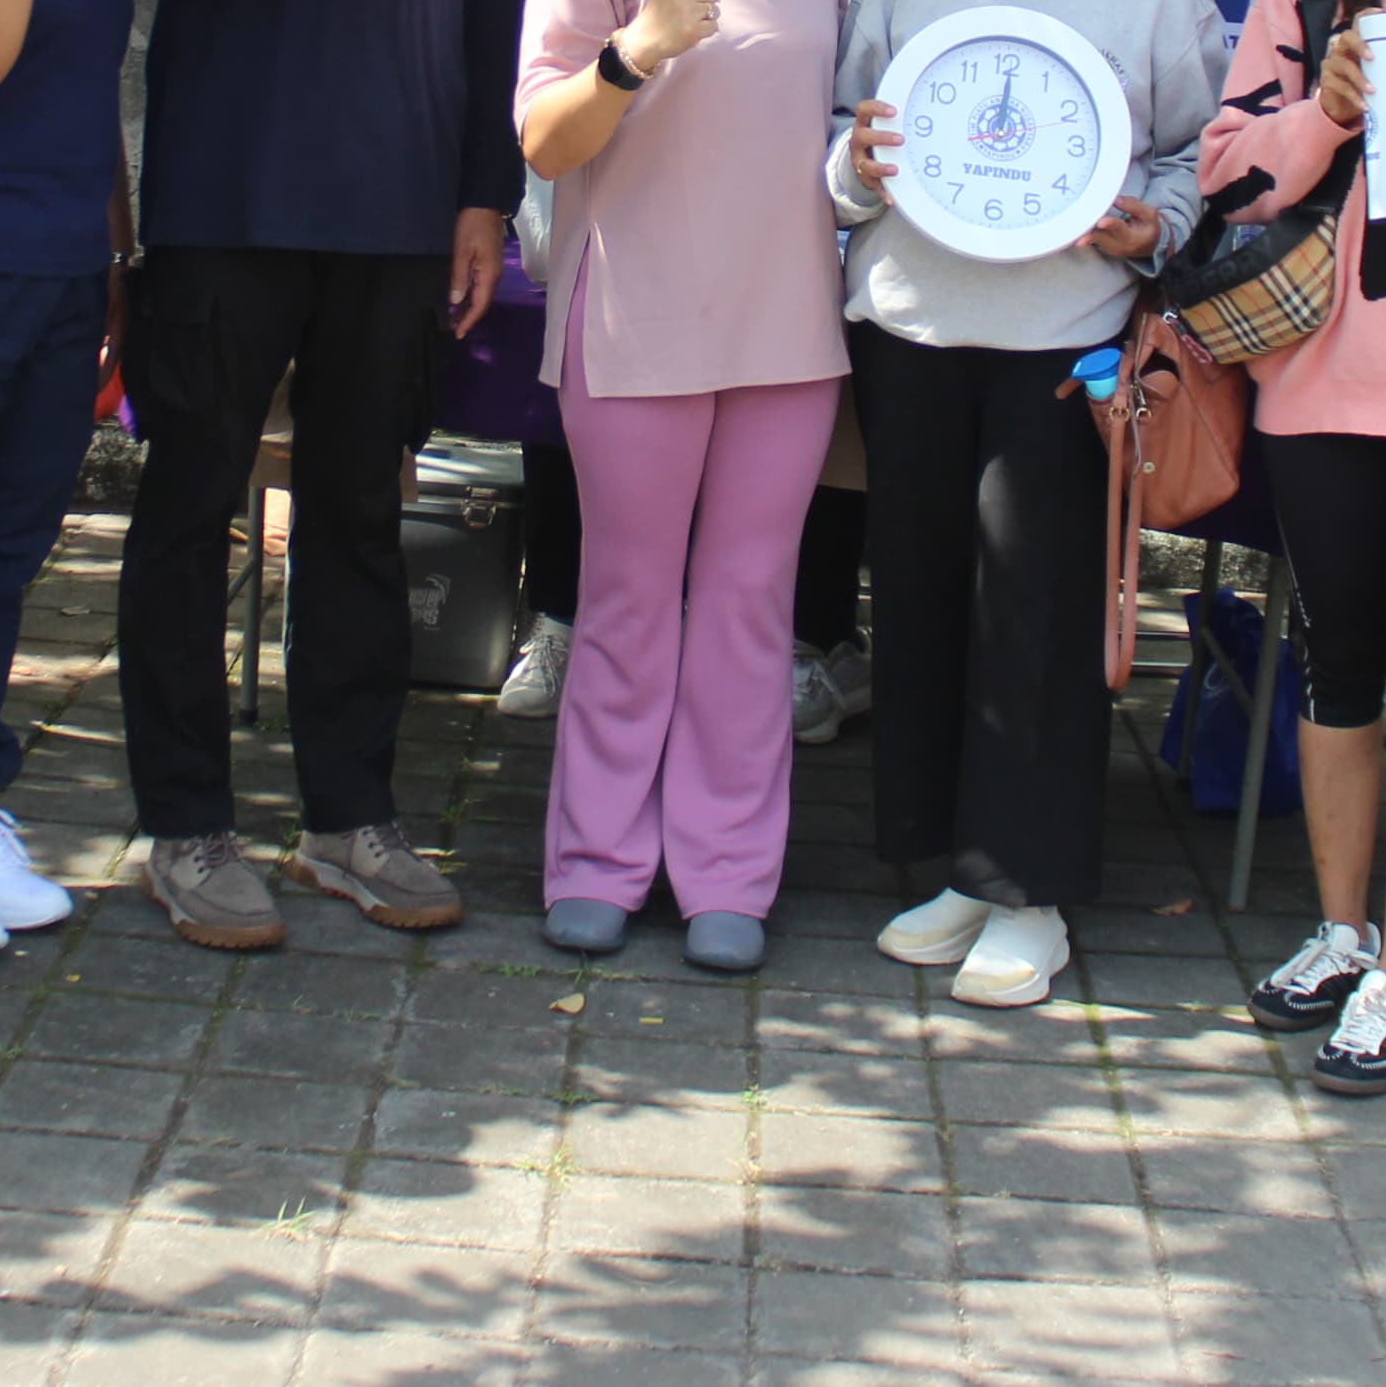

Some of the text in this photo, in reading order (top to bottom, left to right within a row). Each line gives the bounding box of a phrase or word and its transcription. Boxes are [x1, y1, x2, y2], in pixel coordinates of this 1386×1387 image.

[960, 60, 978, 84] 11
[995, 52, 1021, 78] 12
[929, 81, 957, 105] 10
[1042, 70, 1050, 93] 1
[1060, 100, 1079, 124] 2
[914, 115, 933, 138] 9
[1067, 135, 1086, 158] 3
[923, 154, 942, 178] 8
[963, 162, 1032, 182] YAPINDU
[946, 182, 965, 205] 7
[1051, 174, 1070, 195] 4
[984, 199, 1003, 221] 6
[1023, 192, 1041, 216] 5
